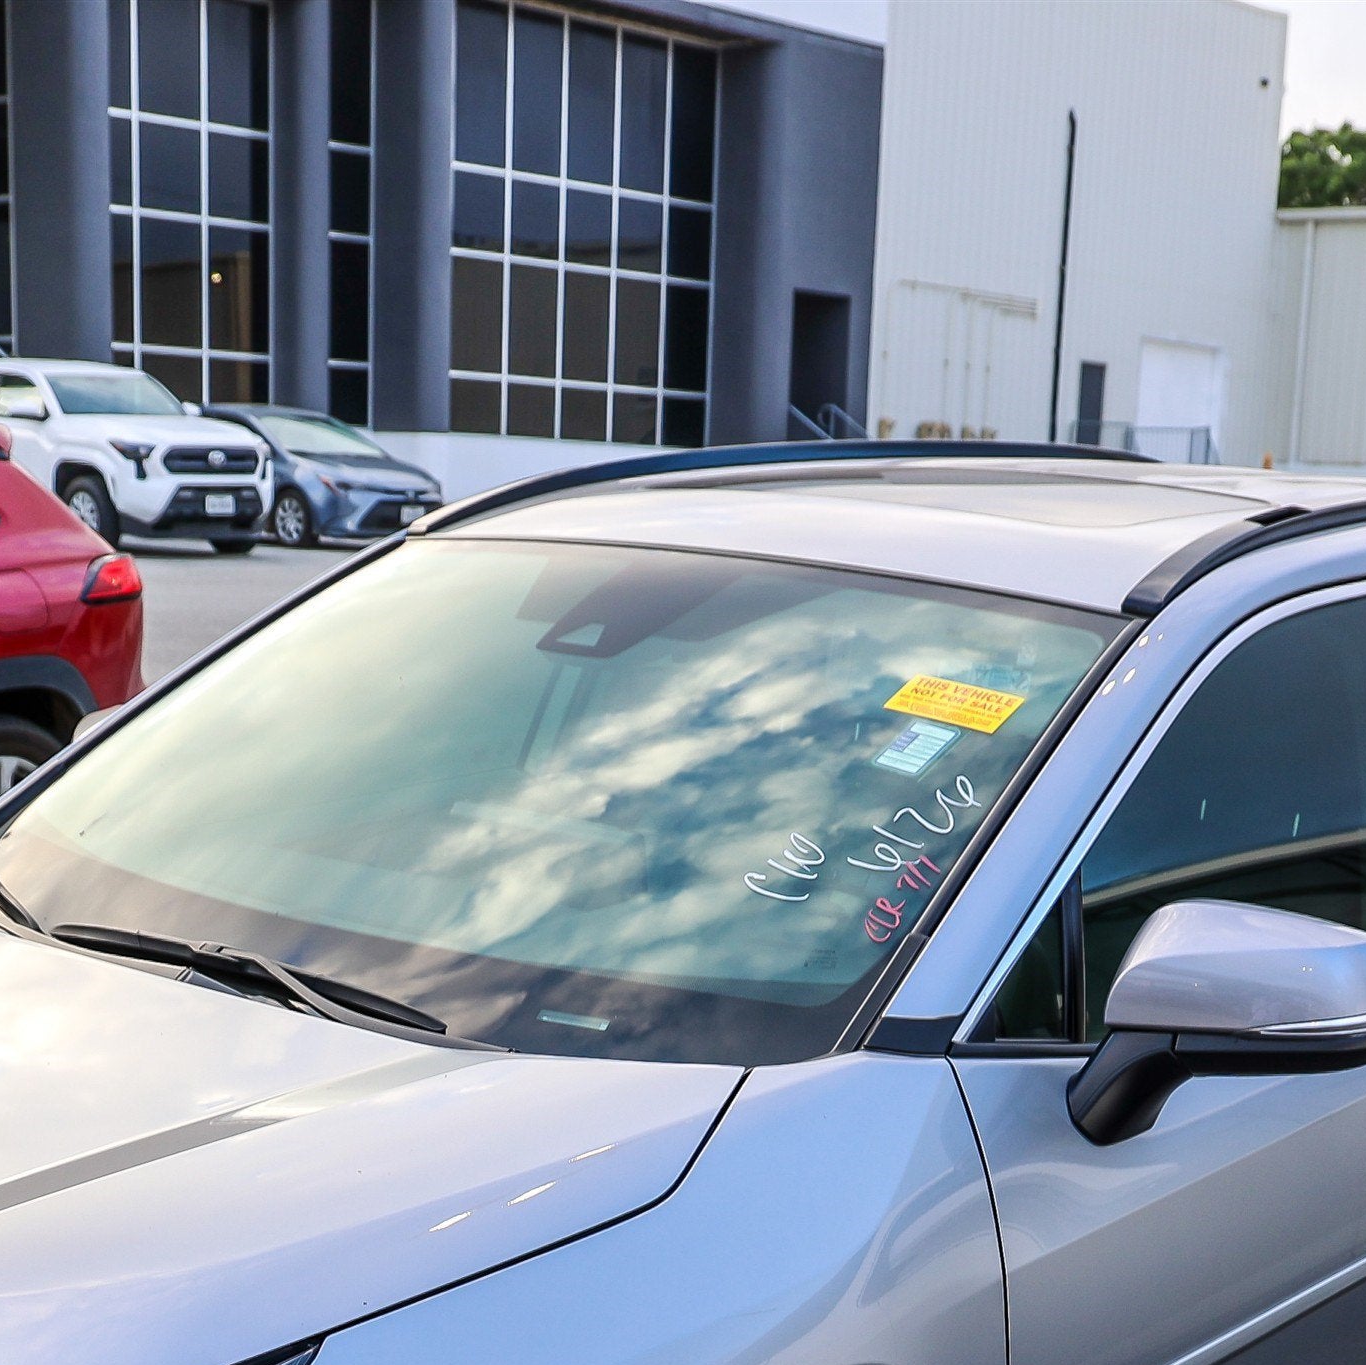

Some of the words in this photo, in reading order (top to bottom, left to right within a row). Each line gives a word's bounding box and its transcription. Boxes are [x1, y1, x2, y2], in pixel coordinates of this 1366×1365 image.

[910, 687, 936, 698] NOT
[939, 693, 967, 705] FOR
[969, 701, 1004, 714] SALE
[916, 678, 950, 691] THIS
[954, 685, 1015, 707] VEHICLE
